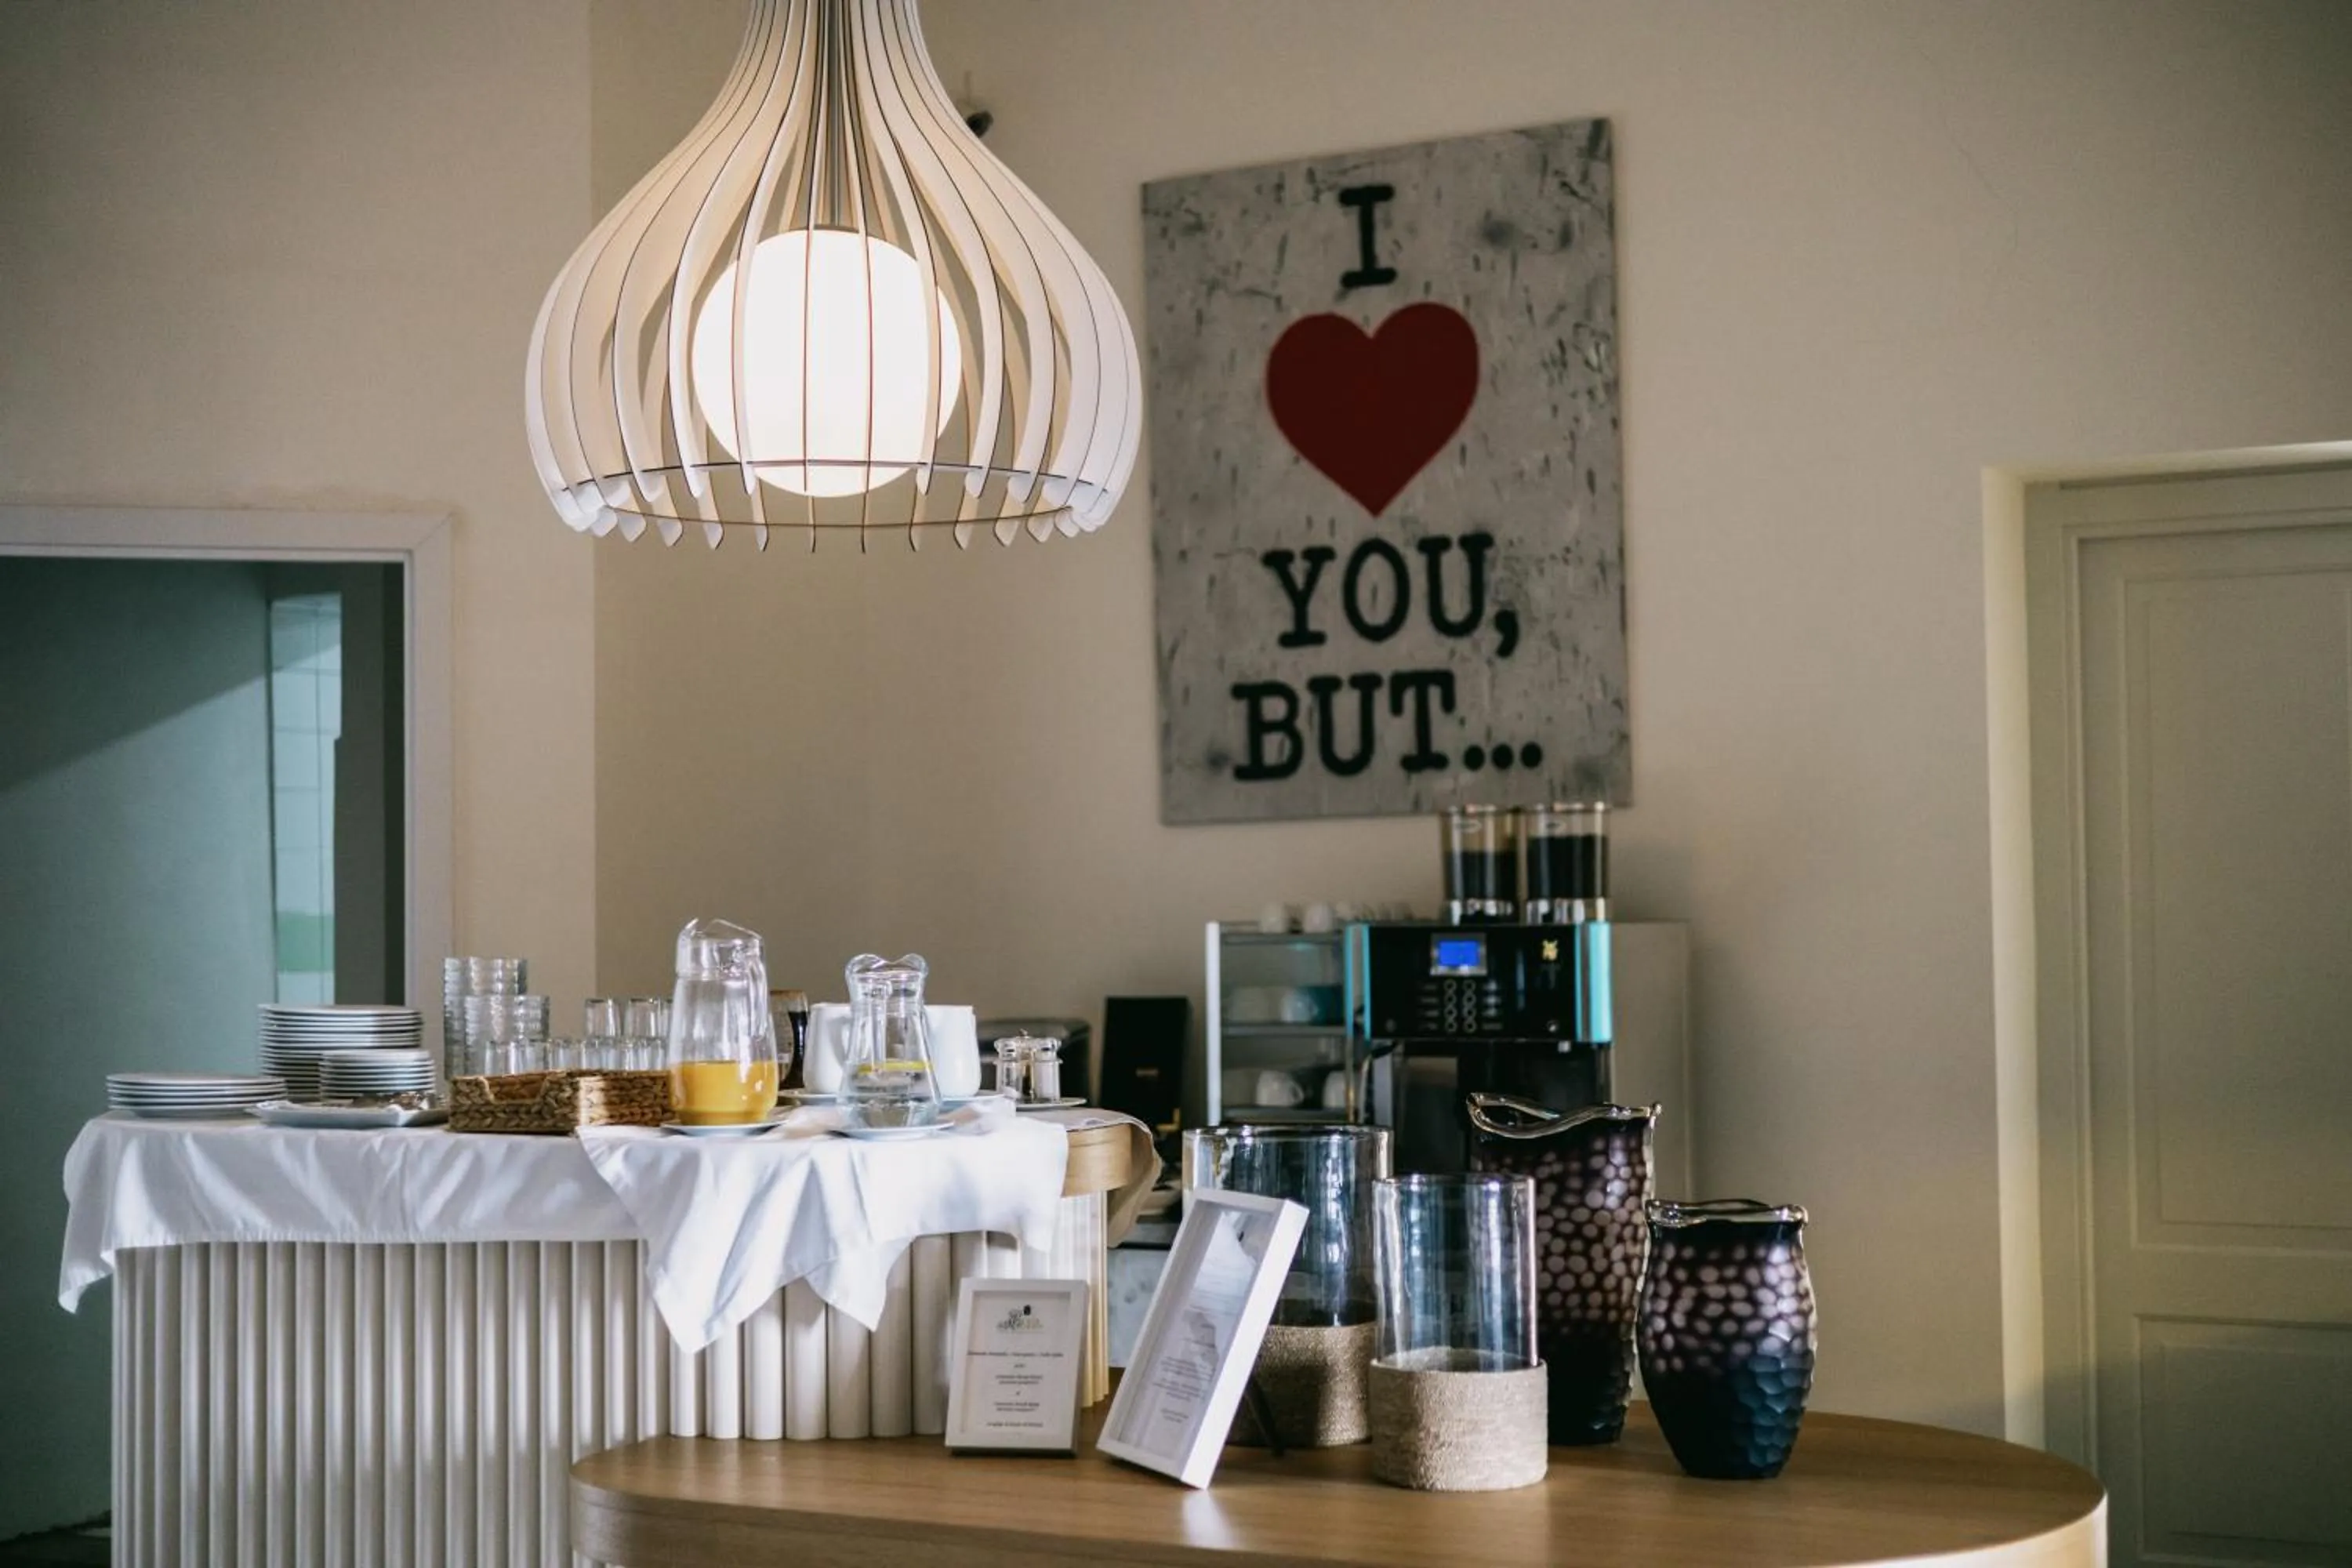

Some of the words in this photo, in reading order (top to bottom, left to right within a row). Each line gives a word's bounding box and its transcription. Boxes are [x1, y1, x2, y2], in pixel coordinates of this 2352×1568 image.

[1338, 184, 1396, 287] I
[1262, 533, 1519, 657] YOU,
[1232, 670, 1542, 780] BUT...
